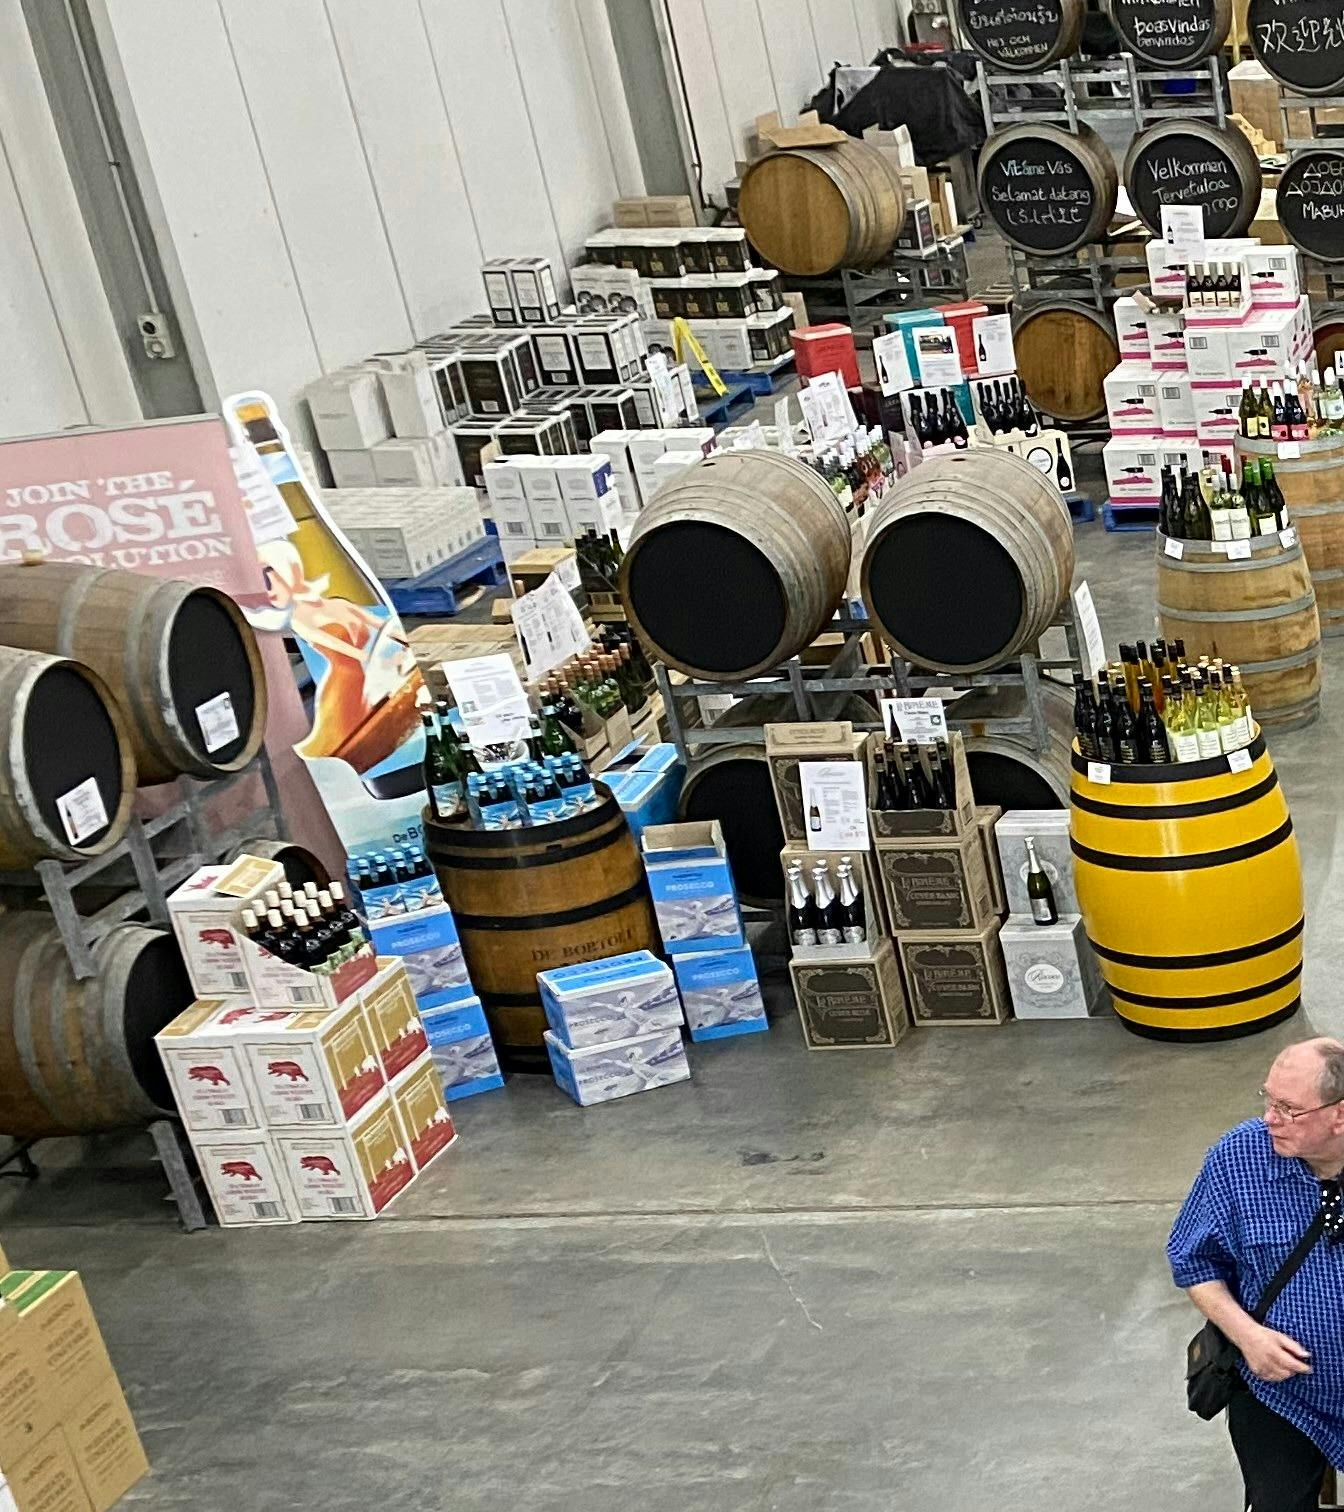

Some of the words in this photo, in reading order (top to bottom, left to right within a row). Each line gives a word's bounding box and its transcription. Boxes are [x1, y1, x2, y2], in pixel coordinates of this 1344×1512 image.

[992, 184, 1046, 201] Selamat
[6, 480, 90, 508] JOIN
[98, 471, 174, 497] THE
[0, 479, 224, 561] ROSÉ
[68, 536, 233, 569] LUTION
